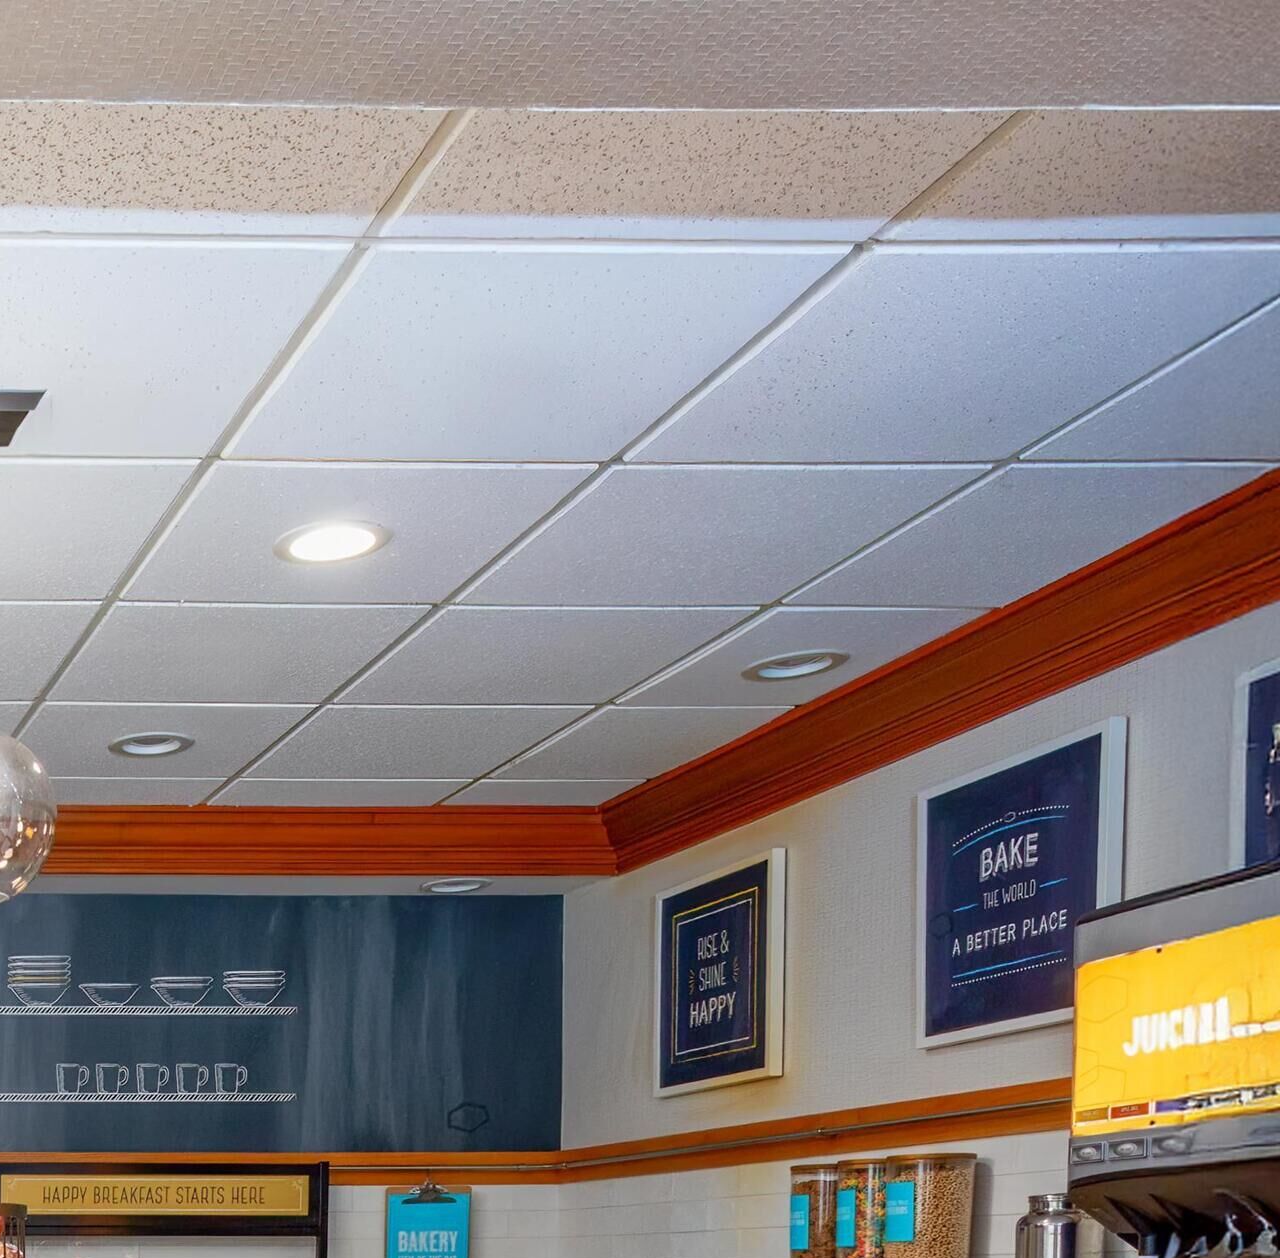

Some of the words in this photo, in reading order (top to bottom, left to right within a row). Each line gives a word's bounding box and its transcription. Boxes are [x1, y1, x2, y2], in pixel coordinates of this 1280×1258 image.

[979, 833, 1040, 882] BAKE
[983, 888, 1000, 910] THE
[1002, 878, 1037, 904] WORLD
[697, 932, 718, 961] RISE
[720, 929, 730, 954] &
[951, 937, 961, 957] A
[966, 923, 1017, 953] BETTER
[1022, 909, 1068, 940] PLACE
[699, 961, 727, 992] SHINE
[689, 991, 737, 1028] HAPPY
[42, 1186, 88, 1205] HAPPY
[93, 1186, 171, 1205] BREAKFAST
[175, 1186, 225, 1205] STARTS
[231, 1186, 265, 1205] HERE
[398, 1230, 459, 1252] BAKERY
